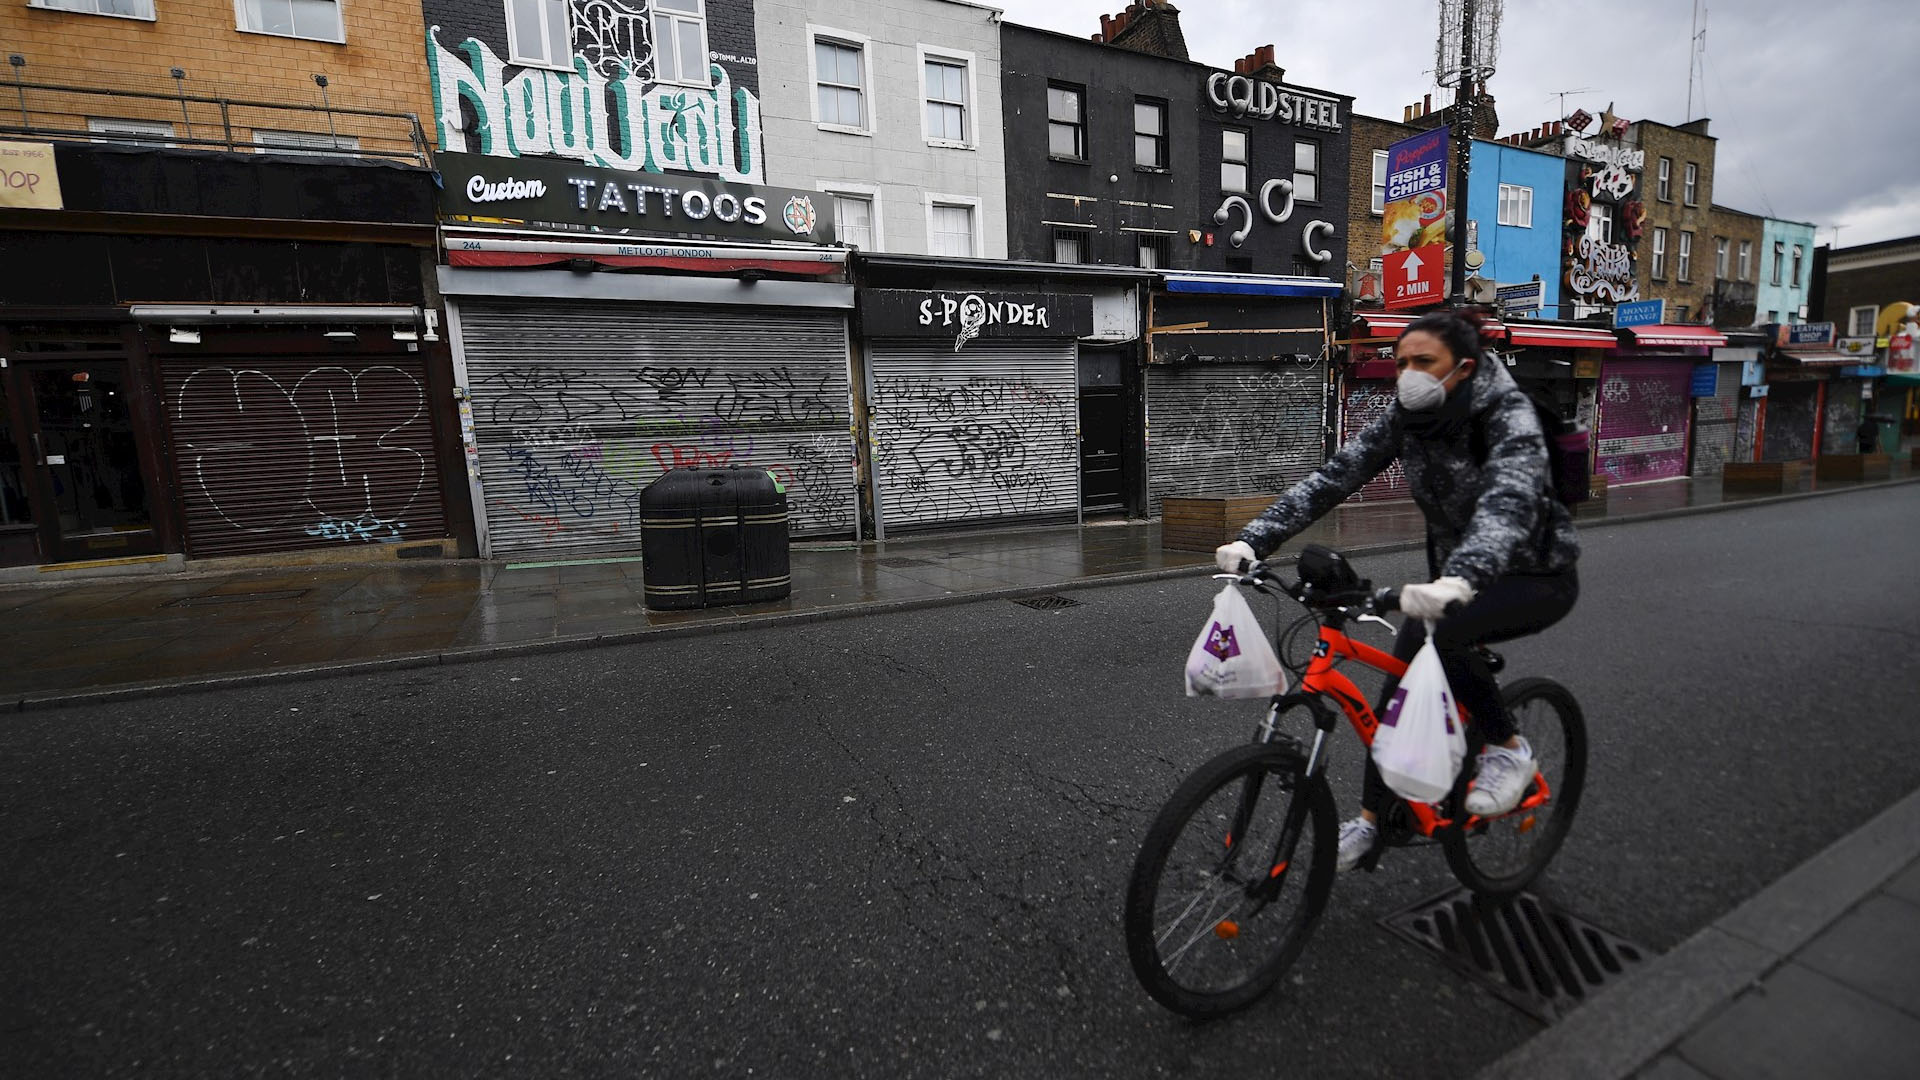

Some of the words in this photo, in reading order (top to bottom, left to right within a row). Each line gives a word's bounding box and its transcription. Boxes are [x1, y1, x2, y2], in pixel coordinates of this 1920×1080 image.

[1207, 72, 1278, 120] COLD
[1278, 92, 1342, 133] STEEL
[1389, 167, 1426, 187] FISH
[1428, 163, 1441, 176] &
[1388, 175, 1442, 198] CHIPS
[466, 174, 547, 204] Custom
[567, 177, 768, 226] TATTOOS
[463, 241, 481, 250] 244
[618, 246, 652, 256] METLO
[656, 248, 668, 256] OF
[672, 249, 712, 258] LONDON
[819, 253, 833, 261] 244
[1396, 285, 1405, 298] 2
[1406, 280, 1430, 296] MIN
[919, 294, 1050, 329] S-PONDER
[1619, 312, 1658, 323] CHANGE
[1622, 305, 1657, 315] MONEY
[1791, 324, 1830, 333] LEATHER
[1799, 332, 1822, 340] SHOP
